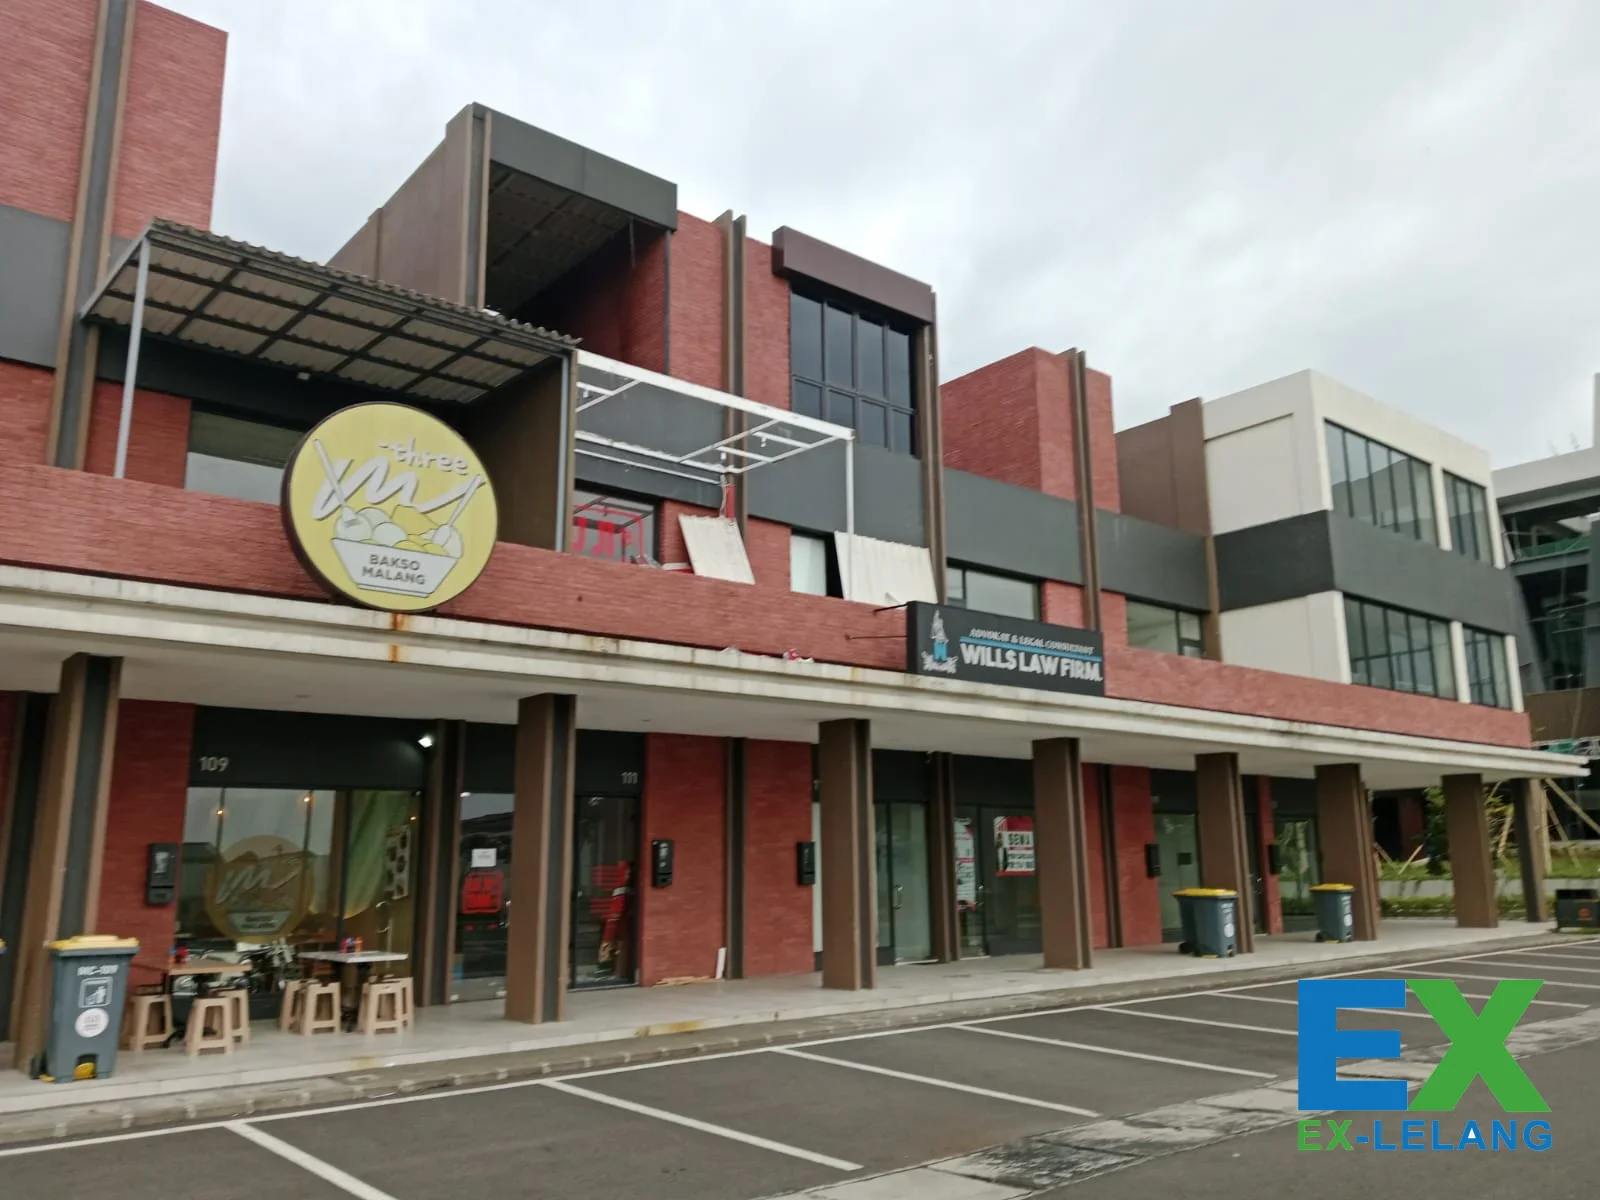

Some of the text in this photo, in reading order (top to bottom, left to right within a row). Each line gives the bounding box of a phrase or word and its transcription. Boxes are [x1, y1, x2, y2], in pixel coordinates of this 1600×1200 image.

[368, 553, 421, 572] BAKSO
[361, 565, 427, 586] MALANG
[960, 644, 1016, 669] WILLS
[1018, 651, 1059, 676] LAW
[198, 753, 230, 773] 109
[619, 770, 638, 785] 111
